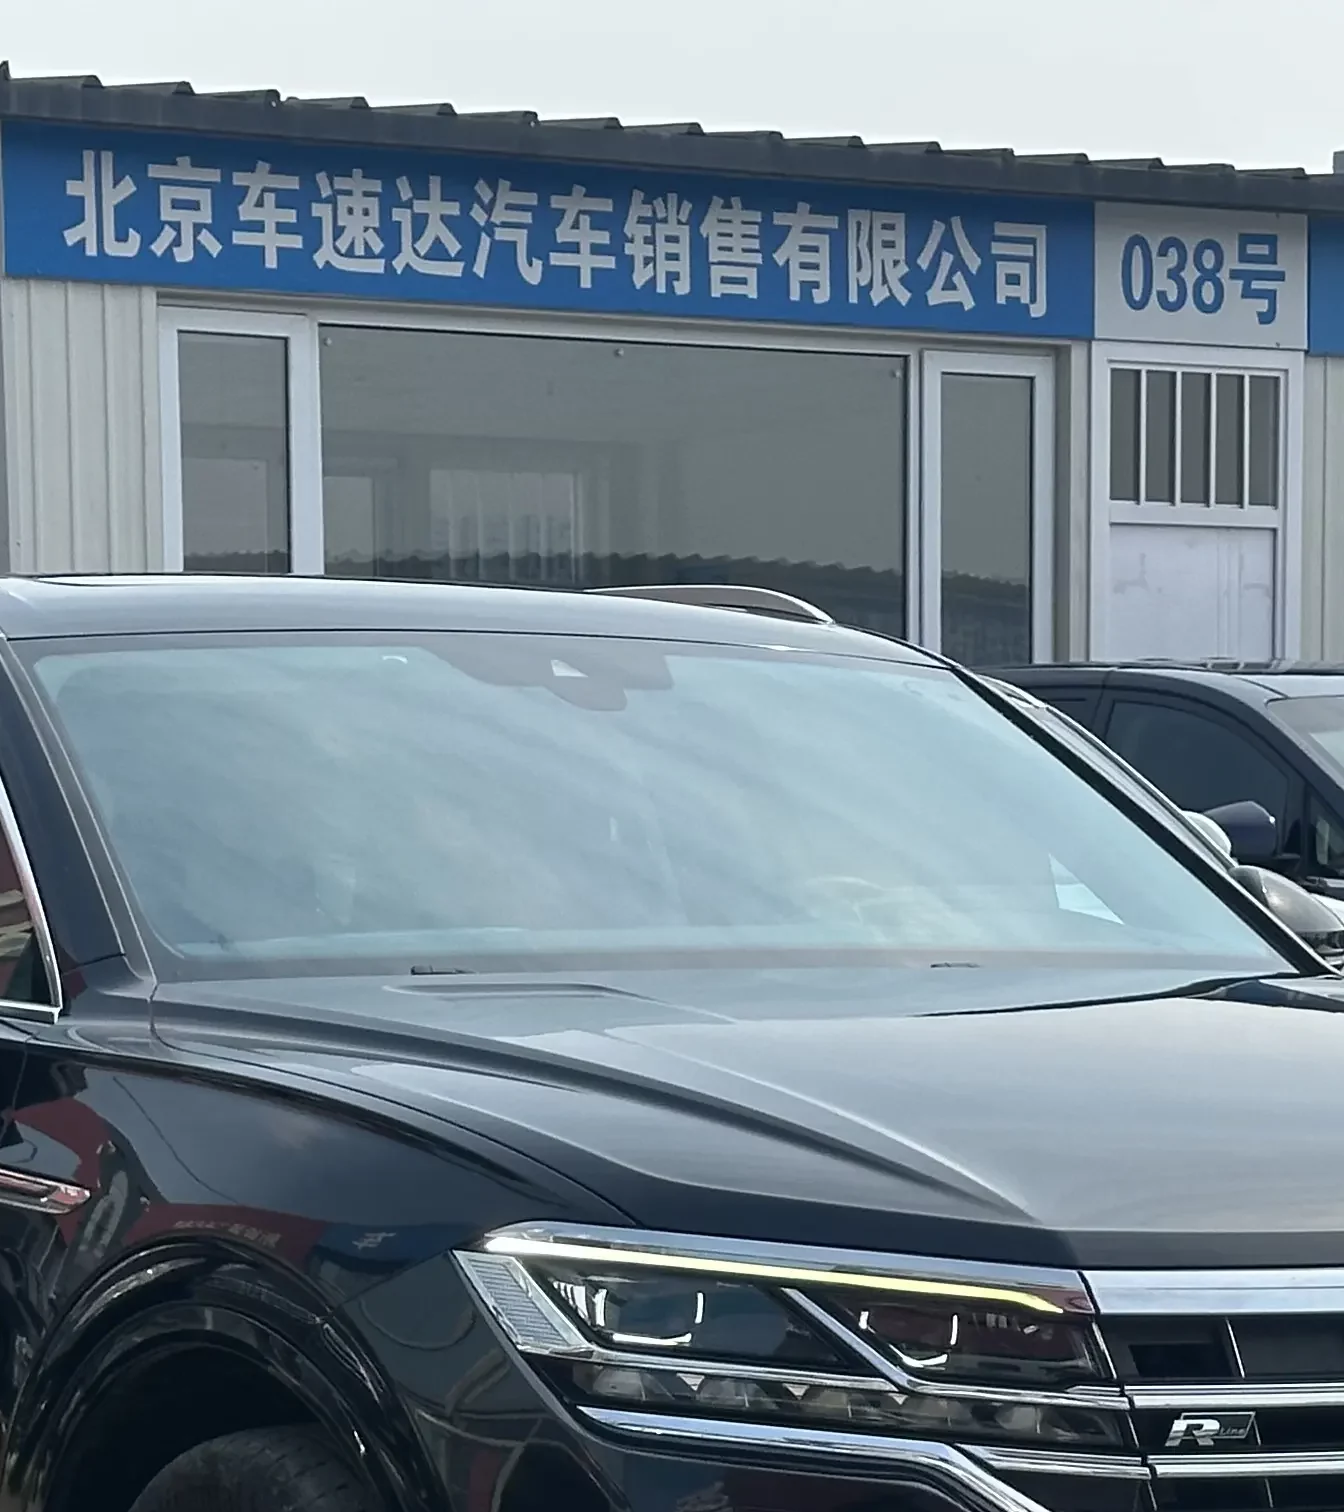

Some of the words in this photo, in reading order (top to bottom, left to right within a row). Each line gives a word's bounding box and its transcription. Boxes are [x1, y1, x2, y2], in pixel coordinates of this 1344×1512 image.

[62, 149, 1048, 319] 北京车速达汽车销售有限公司
[1121, 232, 1286, 325] 038号
